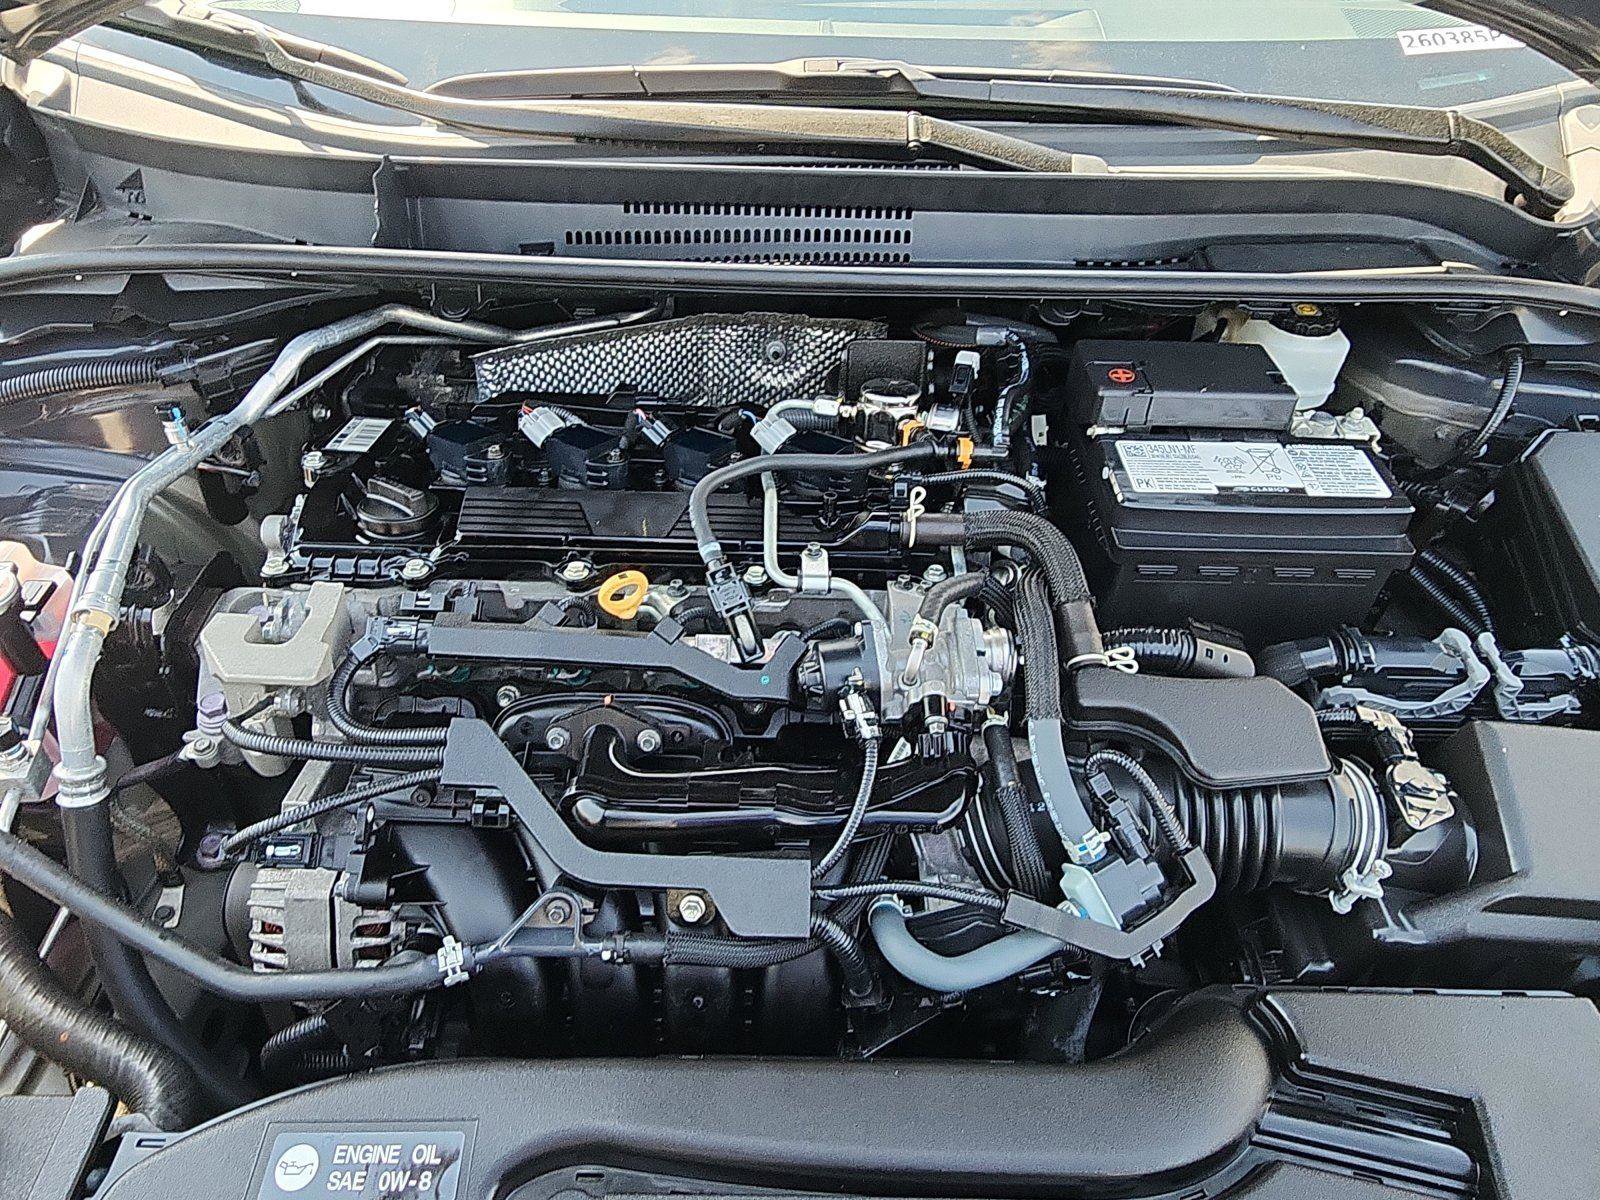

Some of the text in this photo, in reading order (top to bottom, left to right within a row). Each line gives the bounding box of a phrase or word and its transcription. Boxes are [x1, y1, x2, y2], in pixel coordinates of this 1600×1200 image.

[1136, 478, 1154, 489] PK
[333, 1144, 442, 1165] ENGINE OIL
[326, 1170, 433, 1192] SAE 0W-8
